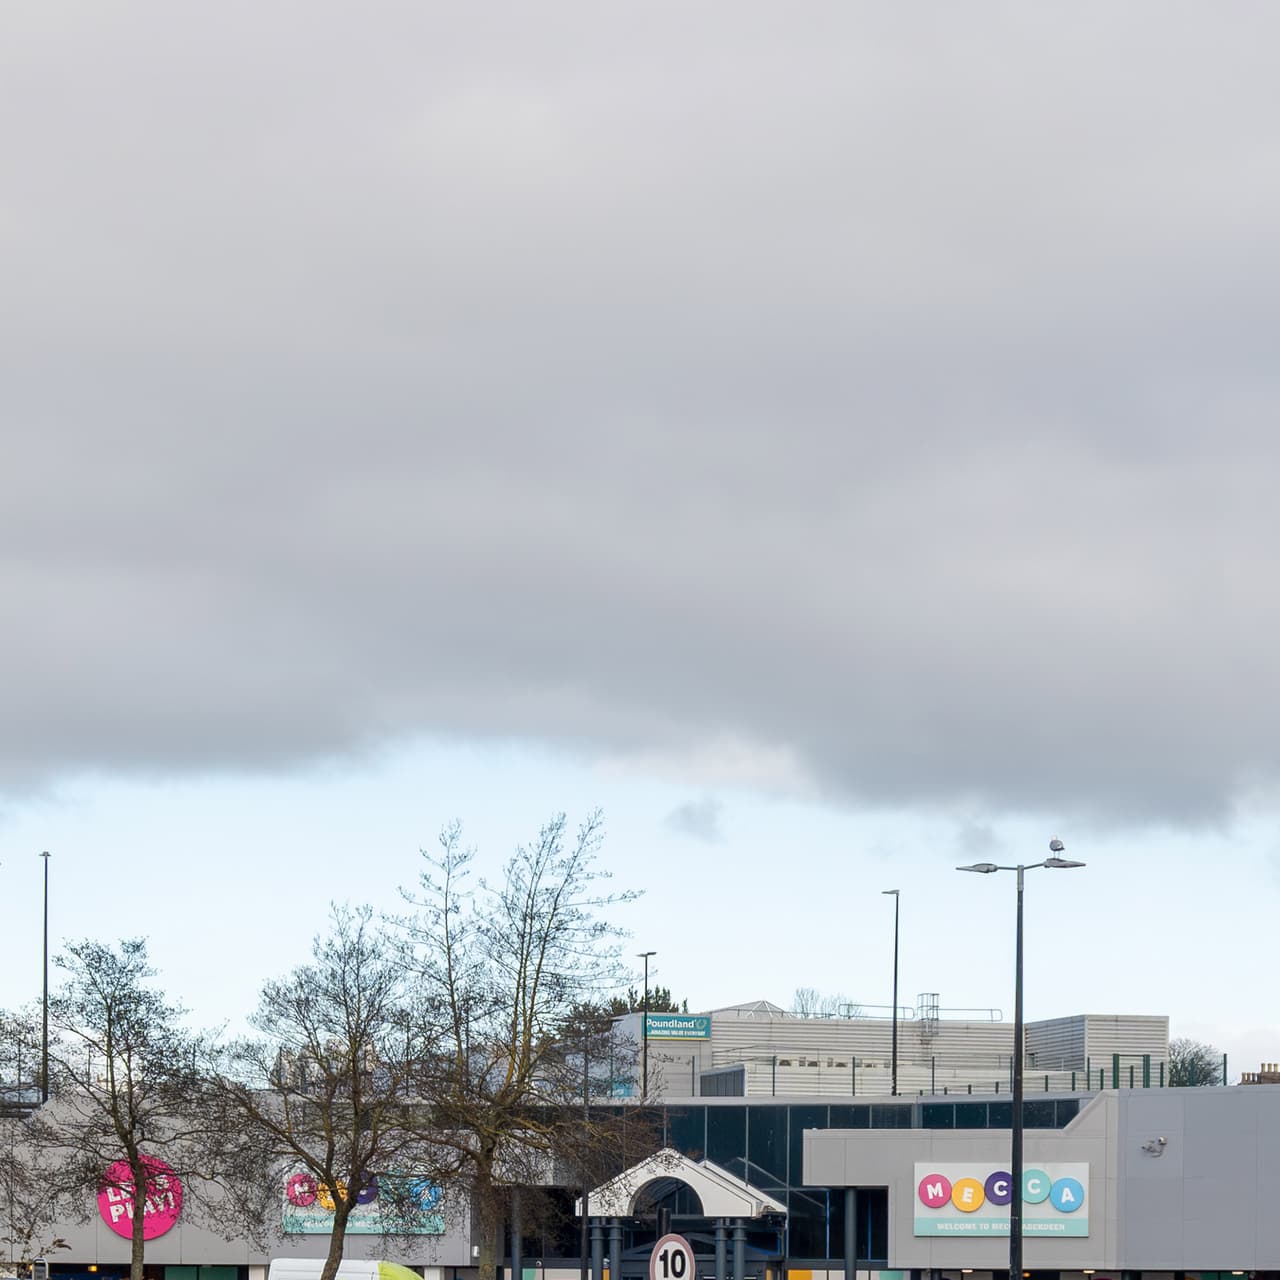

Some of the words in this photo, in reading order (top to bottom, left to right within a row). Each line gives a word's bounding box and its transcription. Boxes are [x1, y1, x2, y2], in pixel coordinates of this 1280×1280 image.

[646, 1018, 695, 1028] Poundland
[927, 1179, 1074, 1204] MECCA
[937, 1222, 976, 1231] WELCOME
[979, 1222, 989, 1231] TO
[660, 1249, 686, 1278] 10
